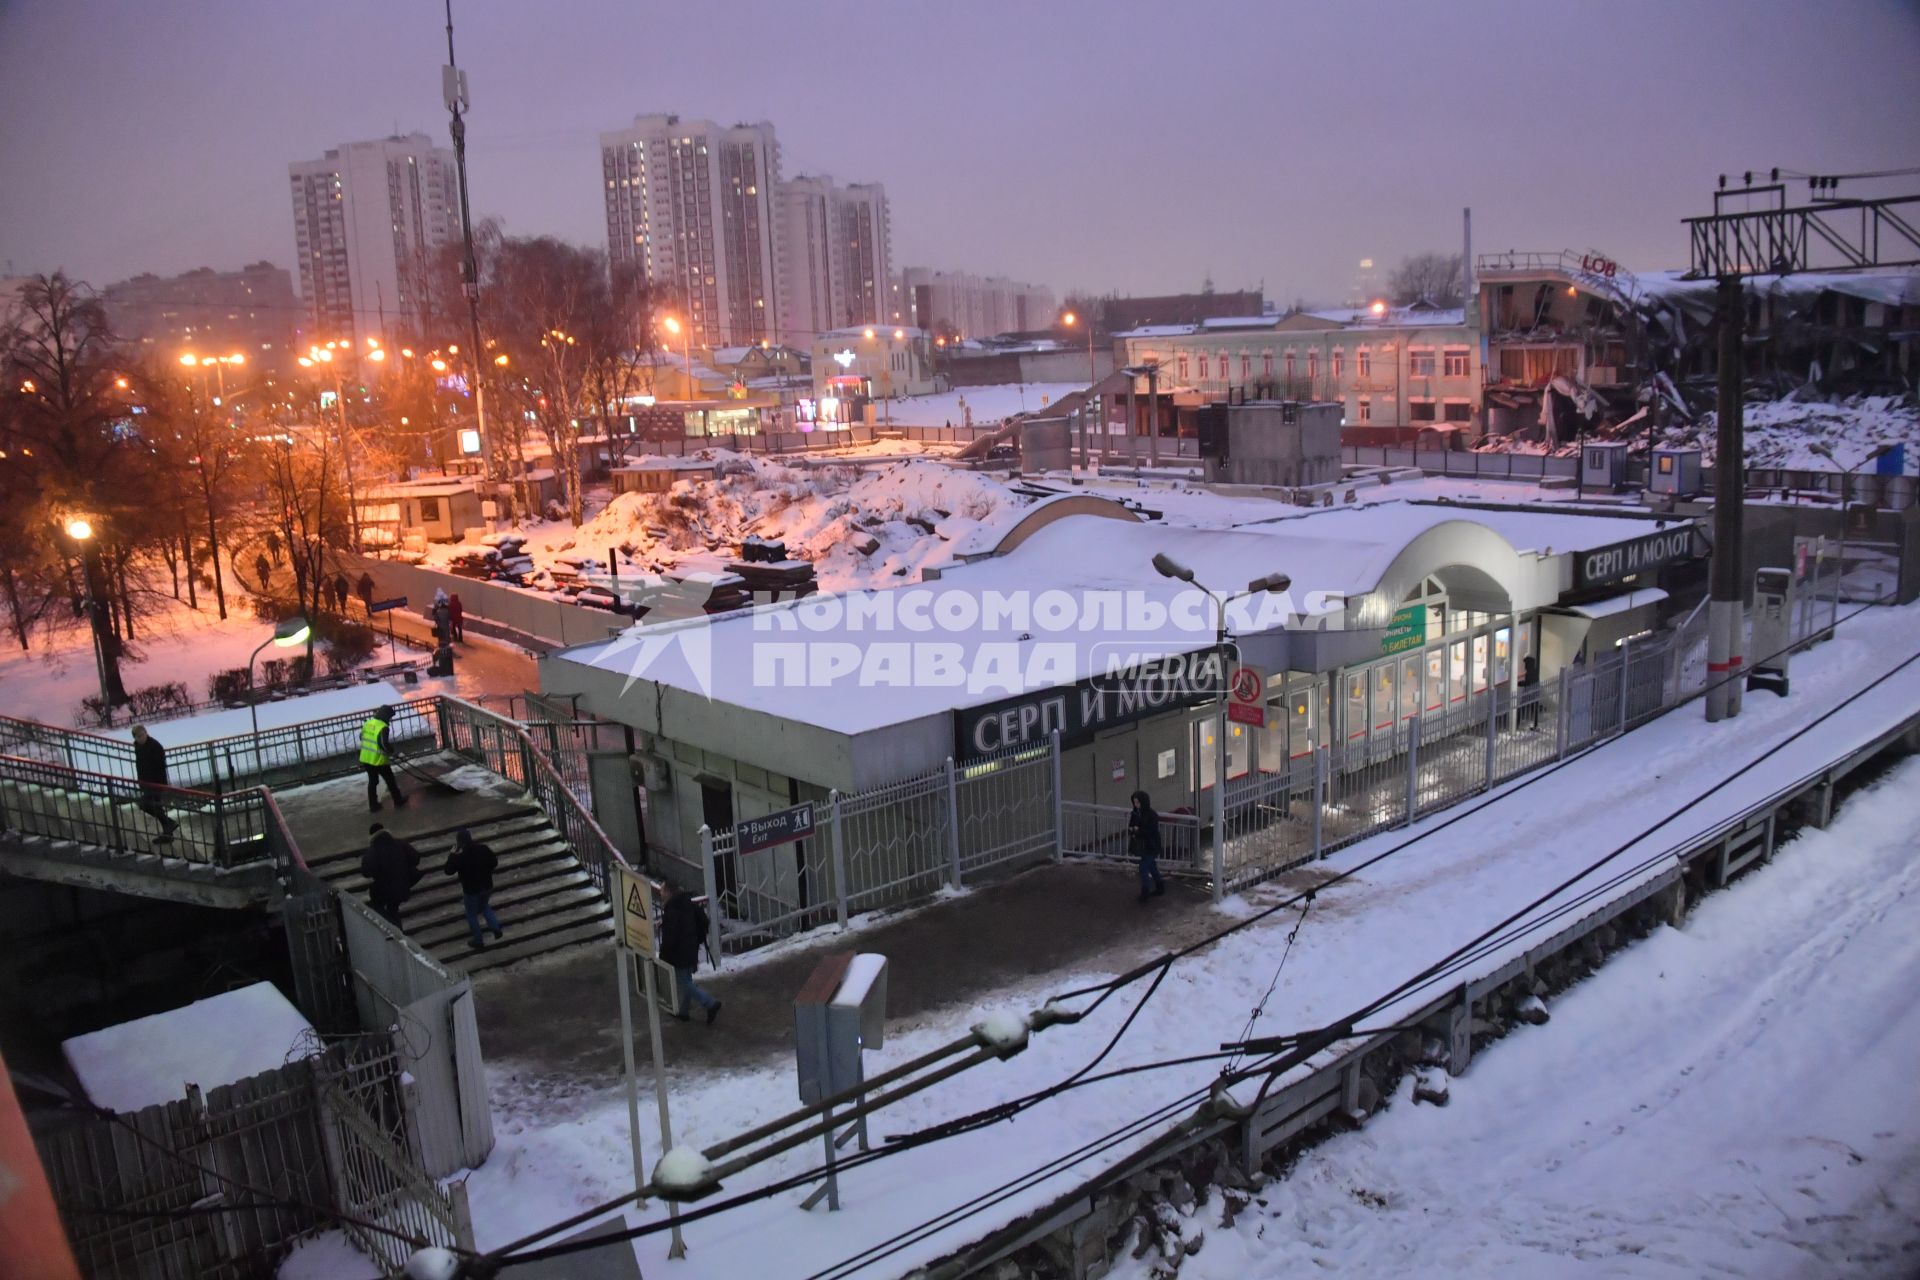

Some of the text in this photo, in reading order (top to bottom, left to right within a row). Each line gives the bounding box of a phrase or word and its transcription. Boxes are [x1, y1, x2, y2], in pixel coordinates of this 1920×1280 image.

[1586, 531, 1690, 580] СЕРП И МОЛОТ
[973, 695, 1067, 754] СЕРП
[1081, 685, 1106, 727] И
[751, 816, 787, 834] Выход
[752, 833, 768, 844] Exit
